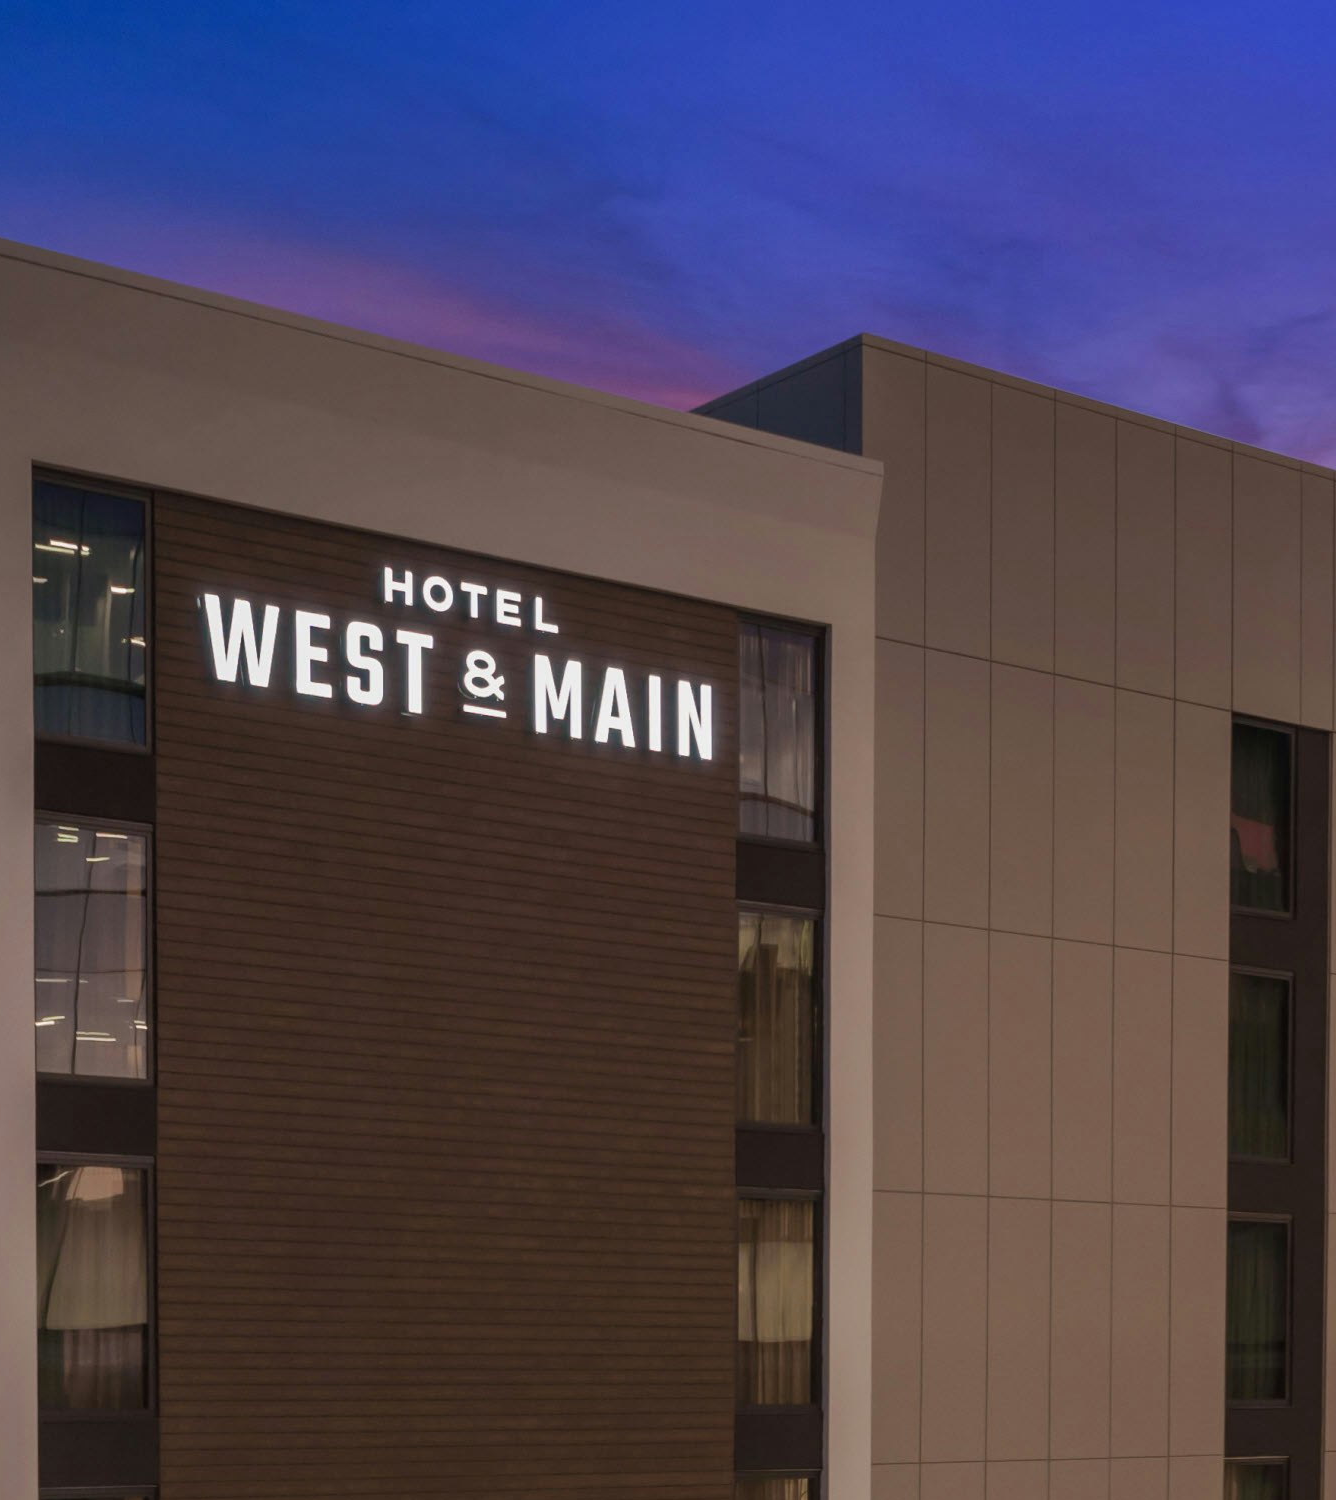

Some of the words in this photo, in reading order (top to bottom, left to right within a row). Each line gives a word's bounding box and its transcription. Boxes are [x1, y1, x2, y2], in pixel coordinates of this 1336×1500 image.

[382, 566, 559, 634] HOTEL
[203, 593, 434, 714] WEST
[463, 650, 506, 701] &
[533, 653, 713, 761] MAIN
